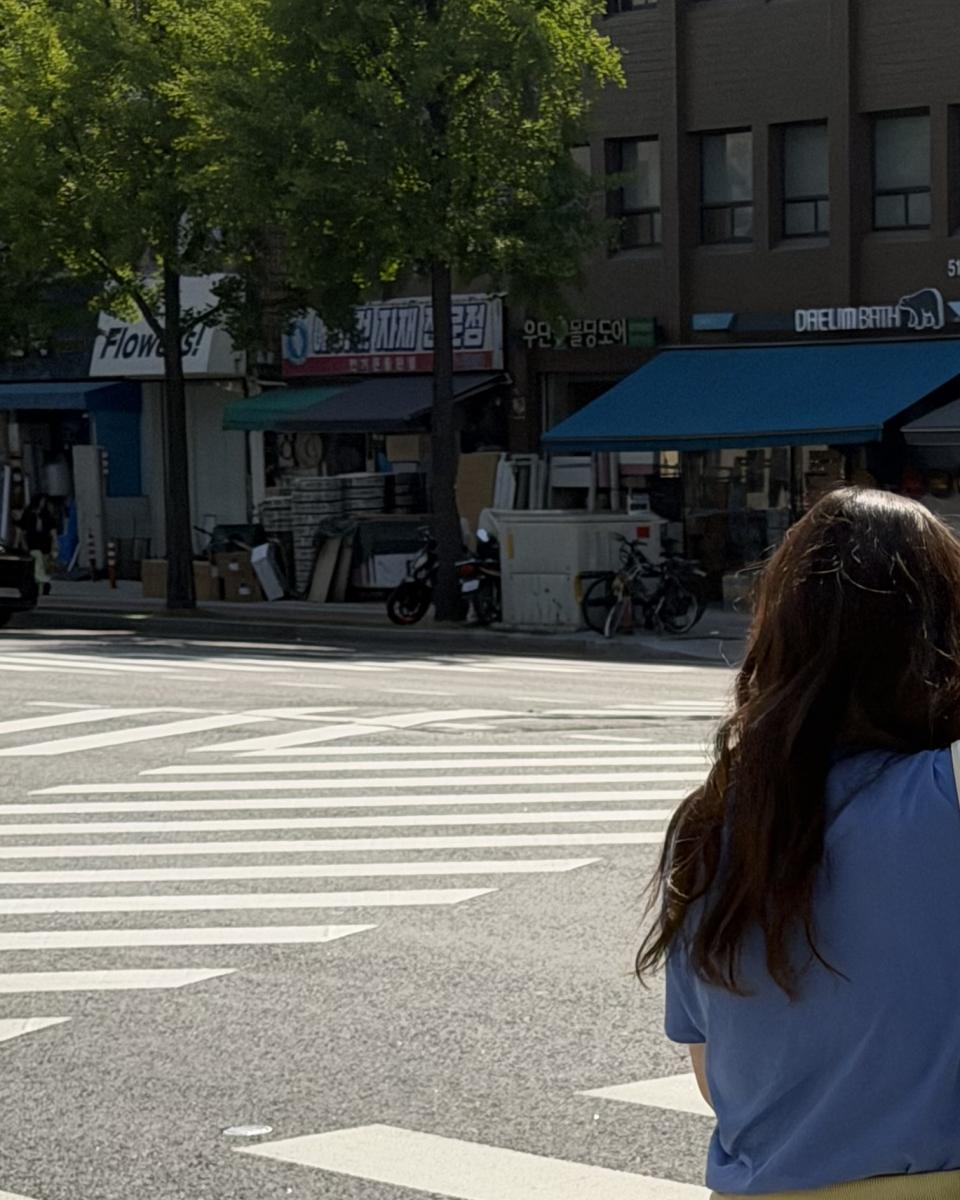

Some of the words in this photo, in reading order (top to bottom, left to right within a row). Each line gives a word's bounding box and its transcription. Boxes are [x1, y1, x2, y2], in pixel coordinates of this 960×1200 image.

[375, 306, 420, 351] 자재
[568, 318, 628, 348] 몰딩도어
[794, 307, 856, 333] DAELIM
[858, 306, 901, 329] BATH
